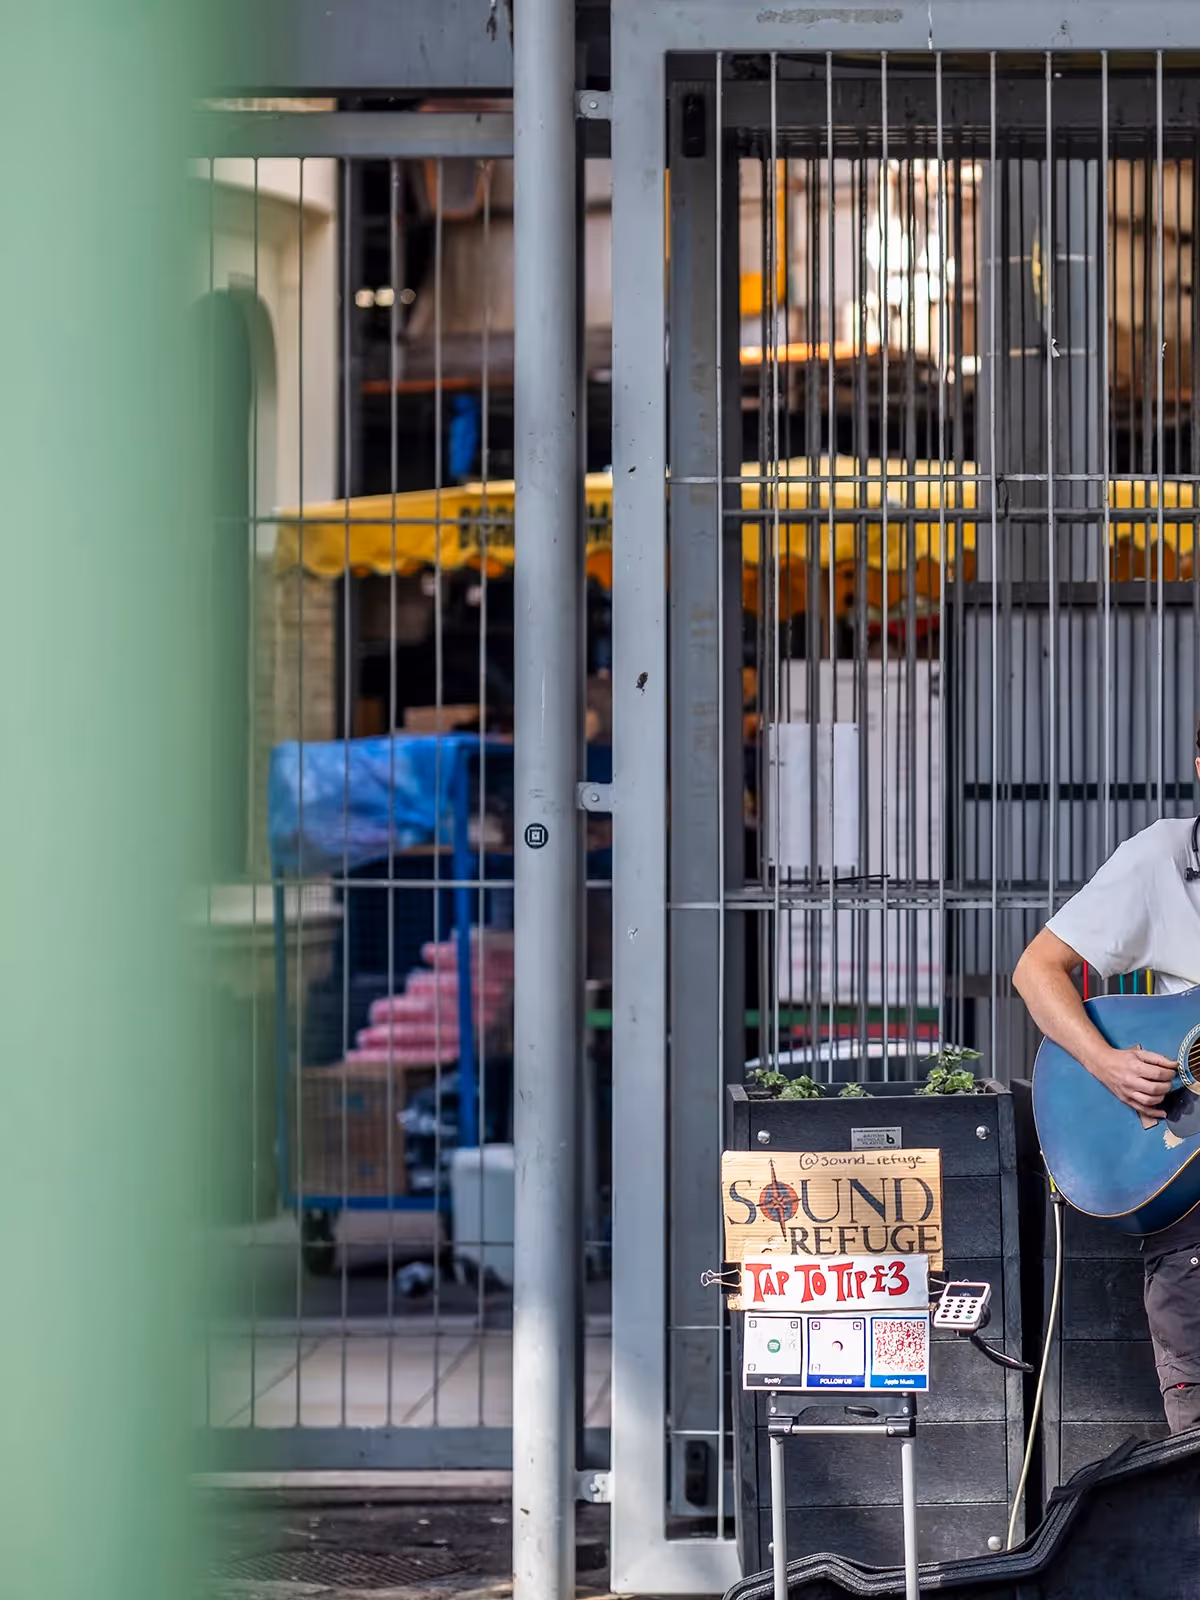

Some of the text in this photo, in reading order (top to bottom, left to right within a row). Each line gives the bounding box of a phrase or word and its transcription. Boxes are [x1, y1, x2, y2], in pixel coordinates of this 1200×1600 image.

[799, 1152, 927, 1170] @sound_refuge
[727, 1177, 934, 1225] SOUND
[788, 1225, 942, 1256] REFUGE
[745, 1261, 910, 1303] TAP TO TIP £3
[764, 1377, 782, 1385] Spotify
[884, 1378, 899, 1386] Apple
